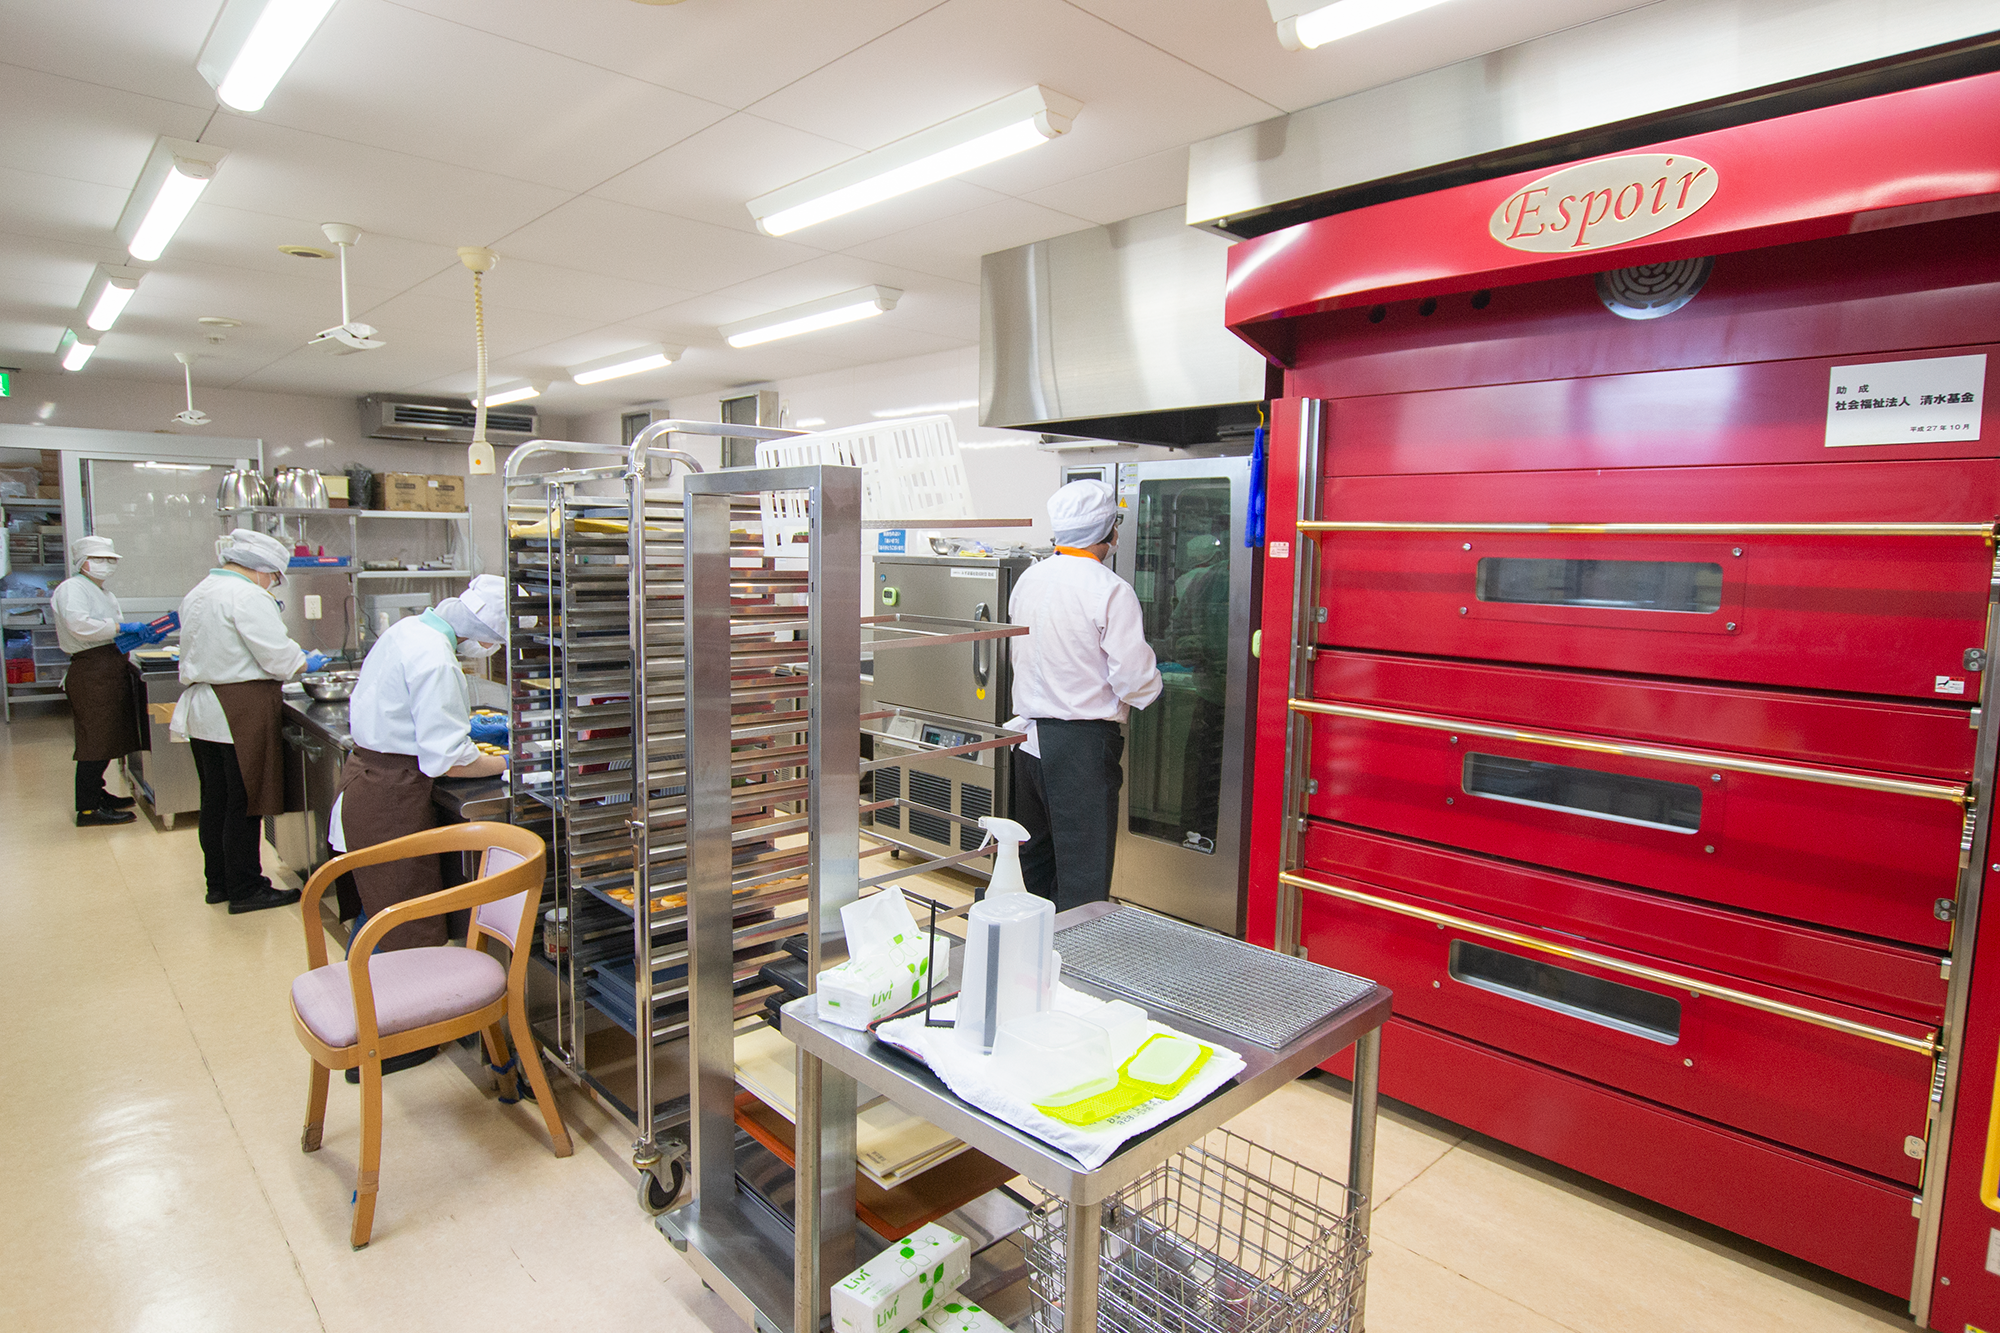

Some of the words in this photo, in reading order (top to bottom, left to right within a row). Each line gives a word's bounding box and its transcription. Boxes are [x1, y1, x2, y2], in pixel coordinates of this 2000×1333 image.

[1504, 158, 1708, 248] Espoir
[1835, 397, 1911, 411] 社会福祉法人
[1919, 392, 1975, 406] 清水基金
[871, 980, 893, 1008] Livi
[843, 1268, 871, 1290] Livi
[877, 1295, 900, 1328] Livi
